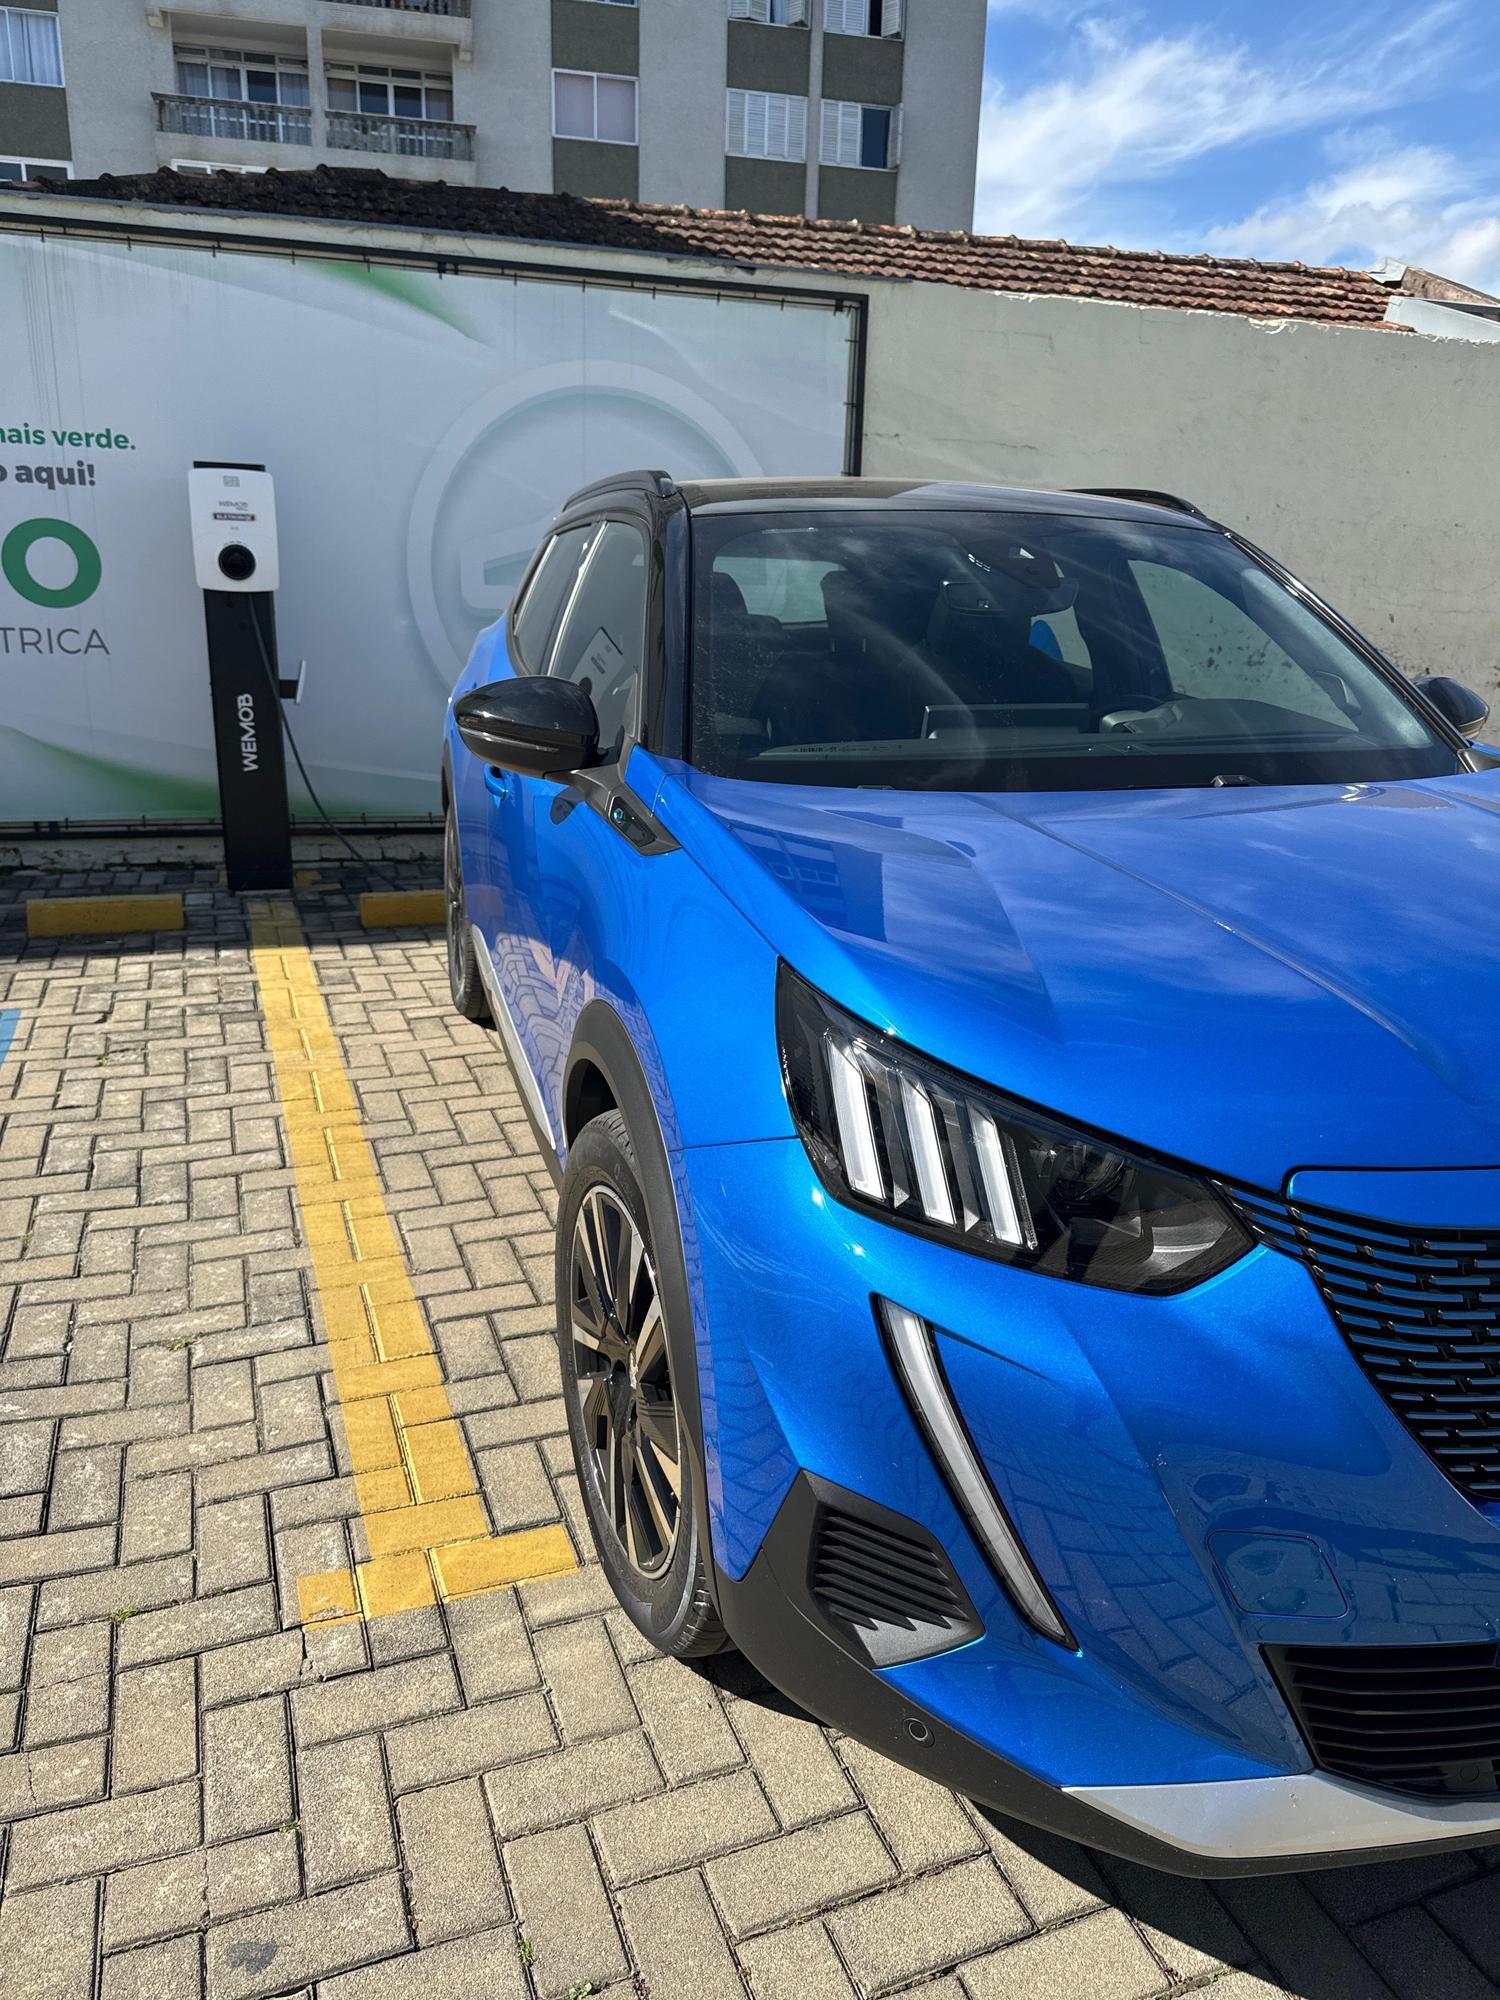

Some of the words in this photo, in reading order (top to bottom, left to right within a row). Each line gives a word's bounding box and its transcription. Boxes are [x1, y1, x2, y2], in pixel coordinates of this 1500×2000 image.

[52, 428, 136, 451] verde.
[15, 460, 96, 490] aqui!
[0, 627, 110, 656] TRICA
[237, 693, 260, 772] WEMOB
